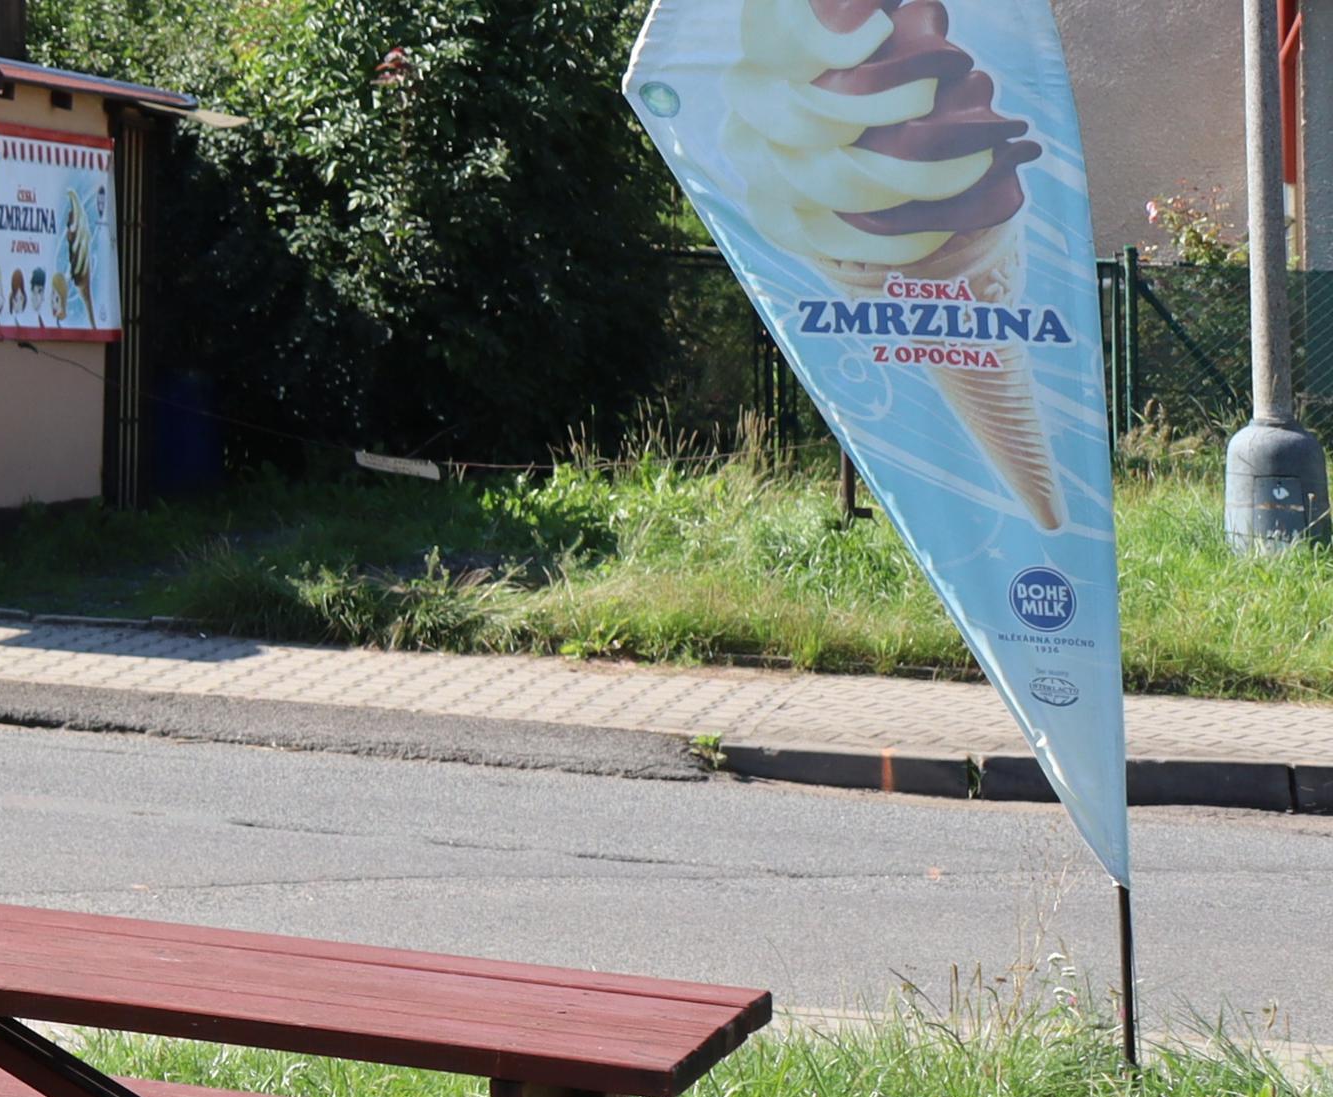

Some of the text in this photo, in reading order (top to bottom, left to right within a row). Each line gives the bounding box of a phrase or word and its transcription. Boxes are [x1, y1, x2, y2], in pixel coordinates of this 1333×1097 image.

[886, 276, 972, 301] ČESKÁ
[798, 300, 1072, 343] ZMRZLINA
[873, 343, 1000, 368] Z OPOČNA
[1016, 583, 1069, 602] BOHE
[1021, 600, 1067, 617] MILK
